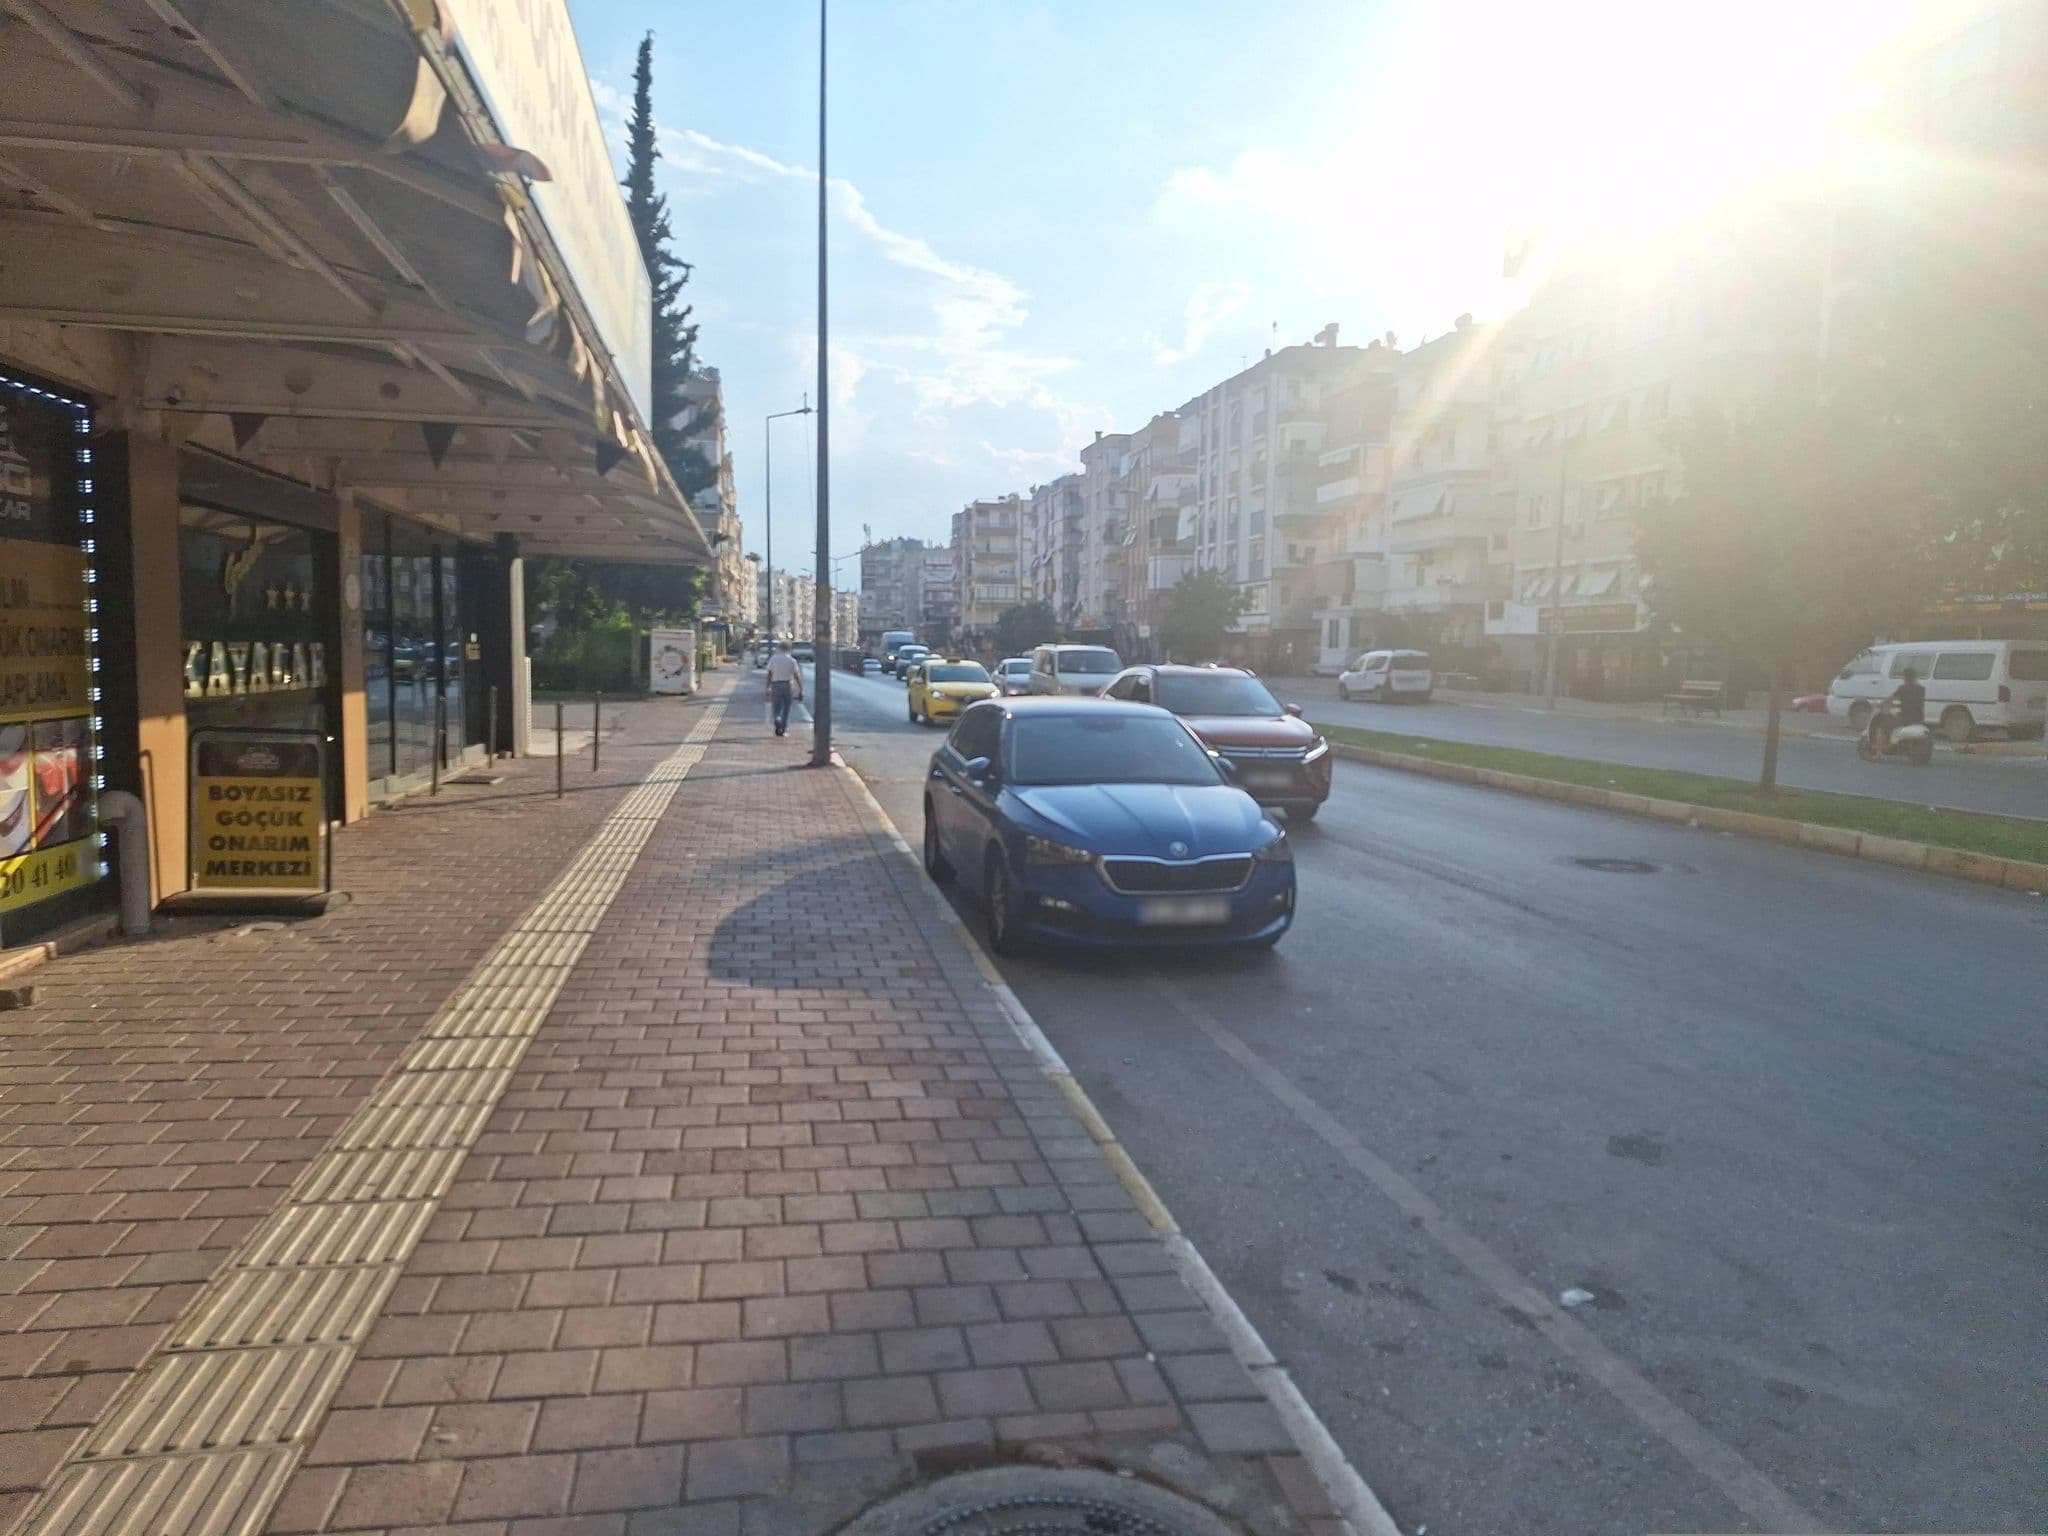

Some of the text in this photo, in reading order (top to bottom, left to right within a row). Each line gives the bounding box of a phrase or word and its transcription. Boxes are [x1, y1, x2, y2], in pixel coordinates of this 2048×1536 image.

[207, 785, 312, 802] BOYASIZ
[215, 807, 304, 832] GÖÇÜK
[208, 835, 311, 852] ONARIM
[206, 857, 311, 876] MERKEZİ
